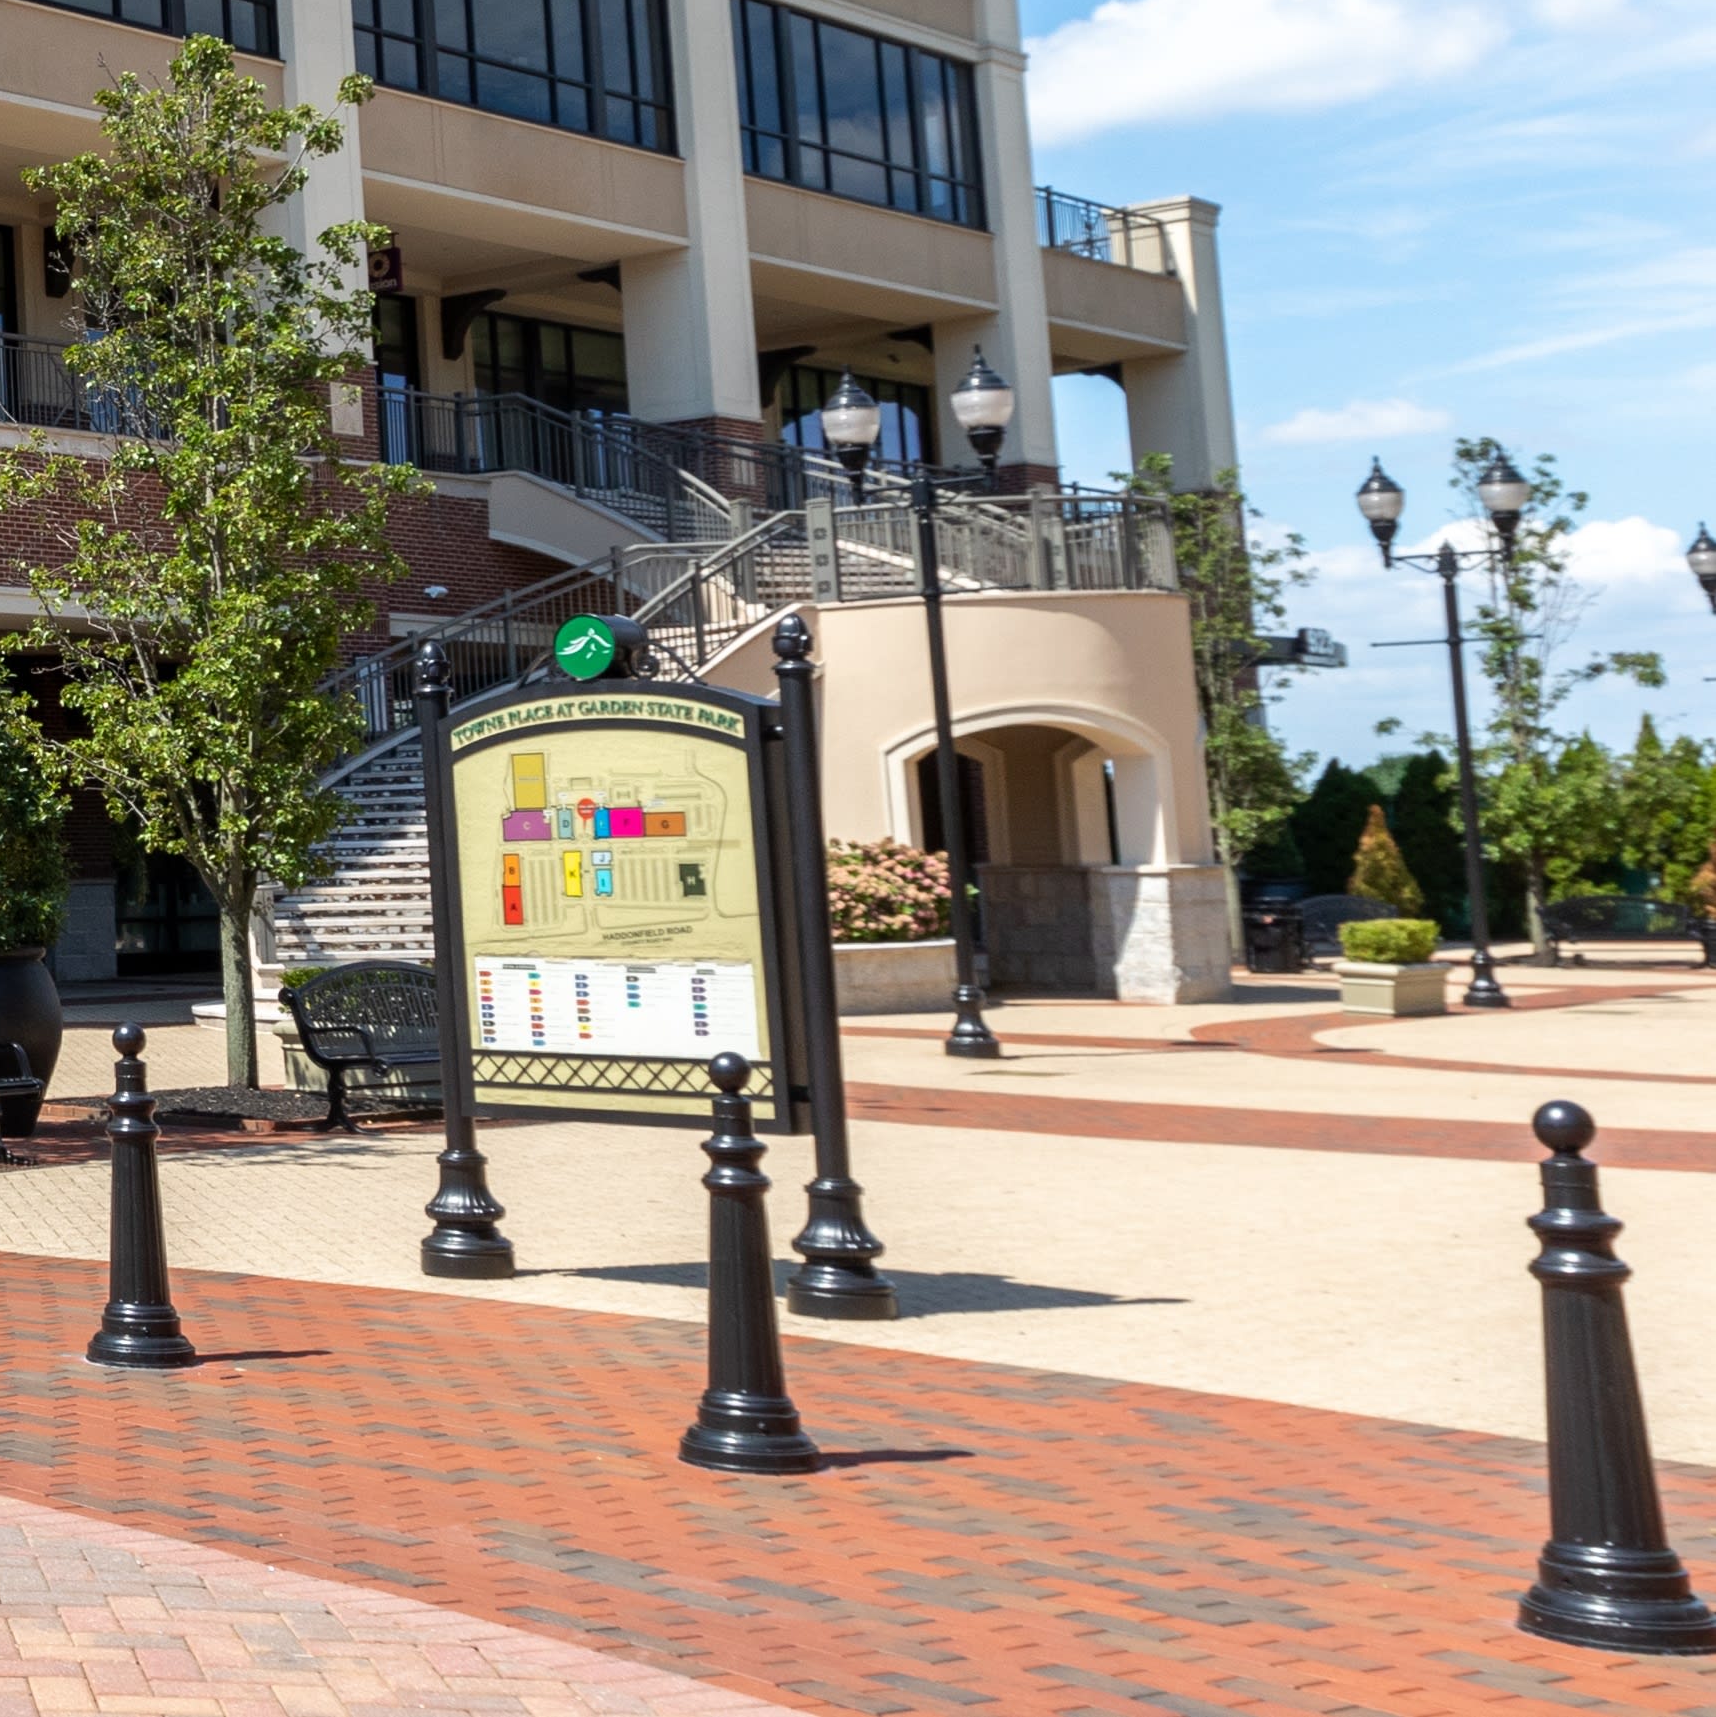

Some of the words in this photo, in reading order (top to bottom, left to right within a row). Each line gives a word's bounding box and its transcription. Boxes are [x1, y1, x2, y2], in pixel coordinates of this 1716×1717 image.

[452, 715, 506, 745] TOWNE
[507, 705, 553, 727] PLACE
[556, 702, 575, 718] AT
[577, 700, 644, 716] GARDEN
[646, 701, 695, 720] STATE
[698, 708, 741, 733] PARK
[562, 819, 570, 828] D
[687, 876, 696, 885] H
[666, 925, 694, 935] ROAD
